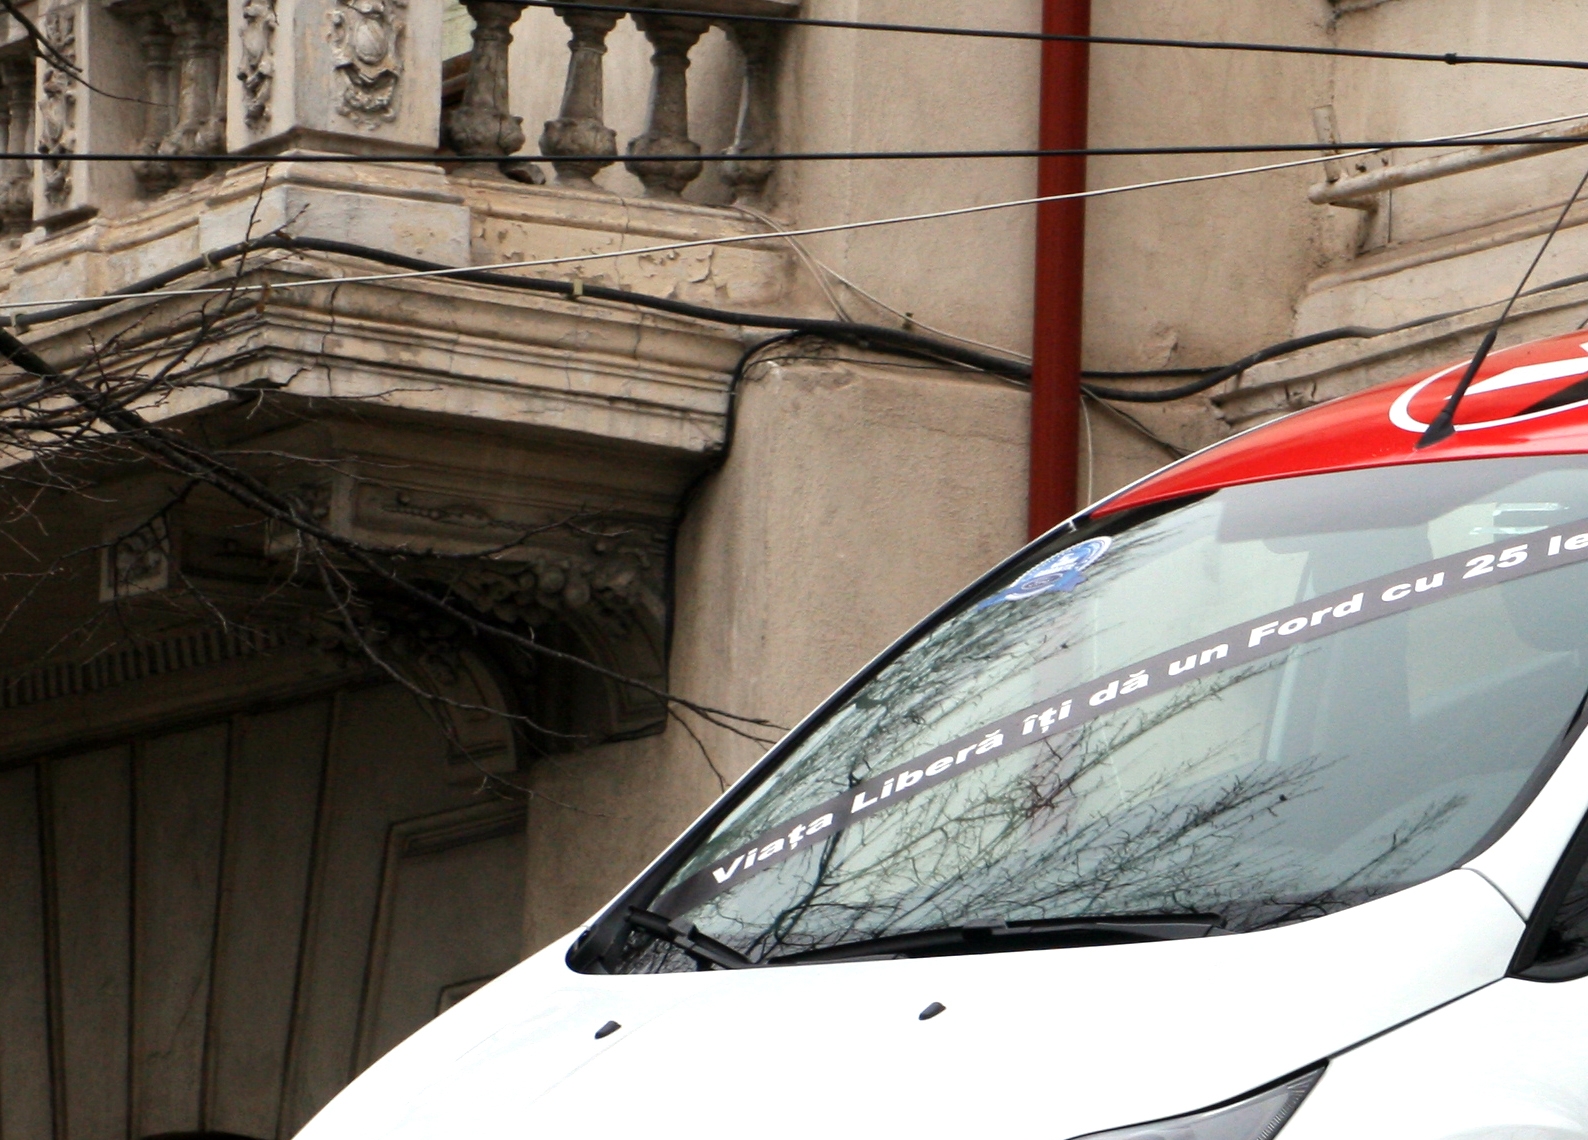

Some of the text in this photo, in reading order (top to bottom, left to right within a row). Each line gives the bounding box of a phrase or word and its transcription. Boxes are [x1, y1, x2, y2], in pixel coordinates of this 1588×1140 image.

[712, 812, 834, 884] Viața
[850, 729, 1004, 815] Liberă
[1022, 699, 1072, 736] îți
[1088, 669, 1150, 707] dă
[1168, 642, 1229, 676] un
[1247, 593, 1364, 649] Ford
[1381, 571, 1445, 602] cu
[1461, 543, 1529, 580] 25
